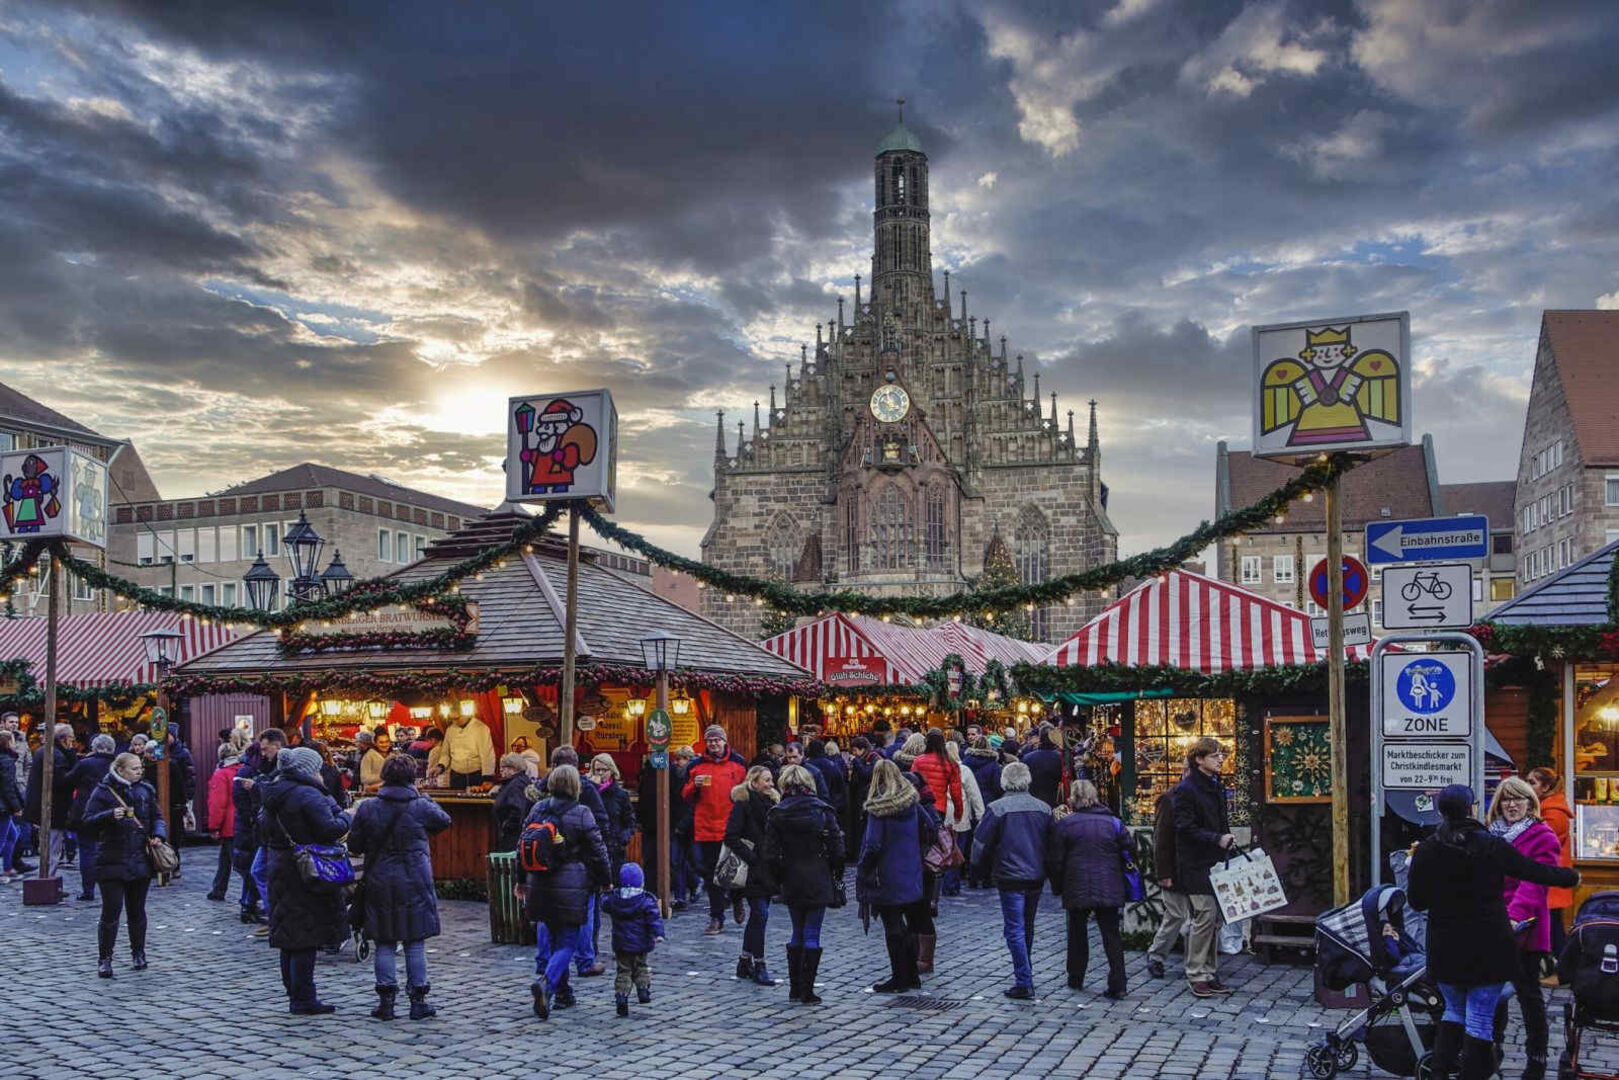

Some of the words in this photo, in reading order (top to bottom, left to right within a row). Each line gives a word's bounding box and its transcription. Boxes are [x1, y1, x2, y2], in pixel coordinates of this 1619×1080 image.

[1400, 532, 1480, 548] Einbahnstraße
[1314, 625, 1367, 638] Retsweg
[1404, 717, 1449, 732] ZONE
[1387, 750, 1449, 759] Marktbeschicker
[1390, 761, 1462, 771] Christkindlesmarkt
[1440, 775, 1453, 784] frei
